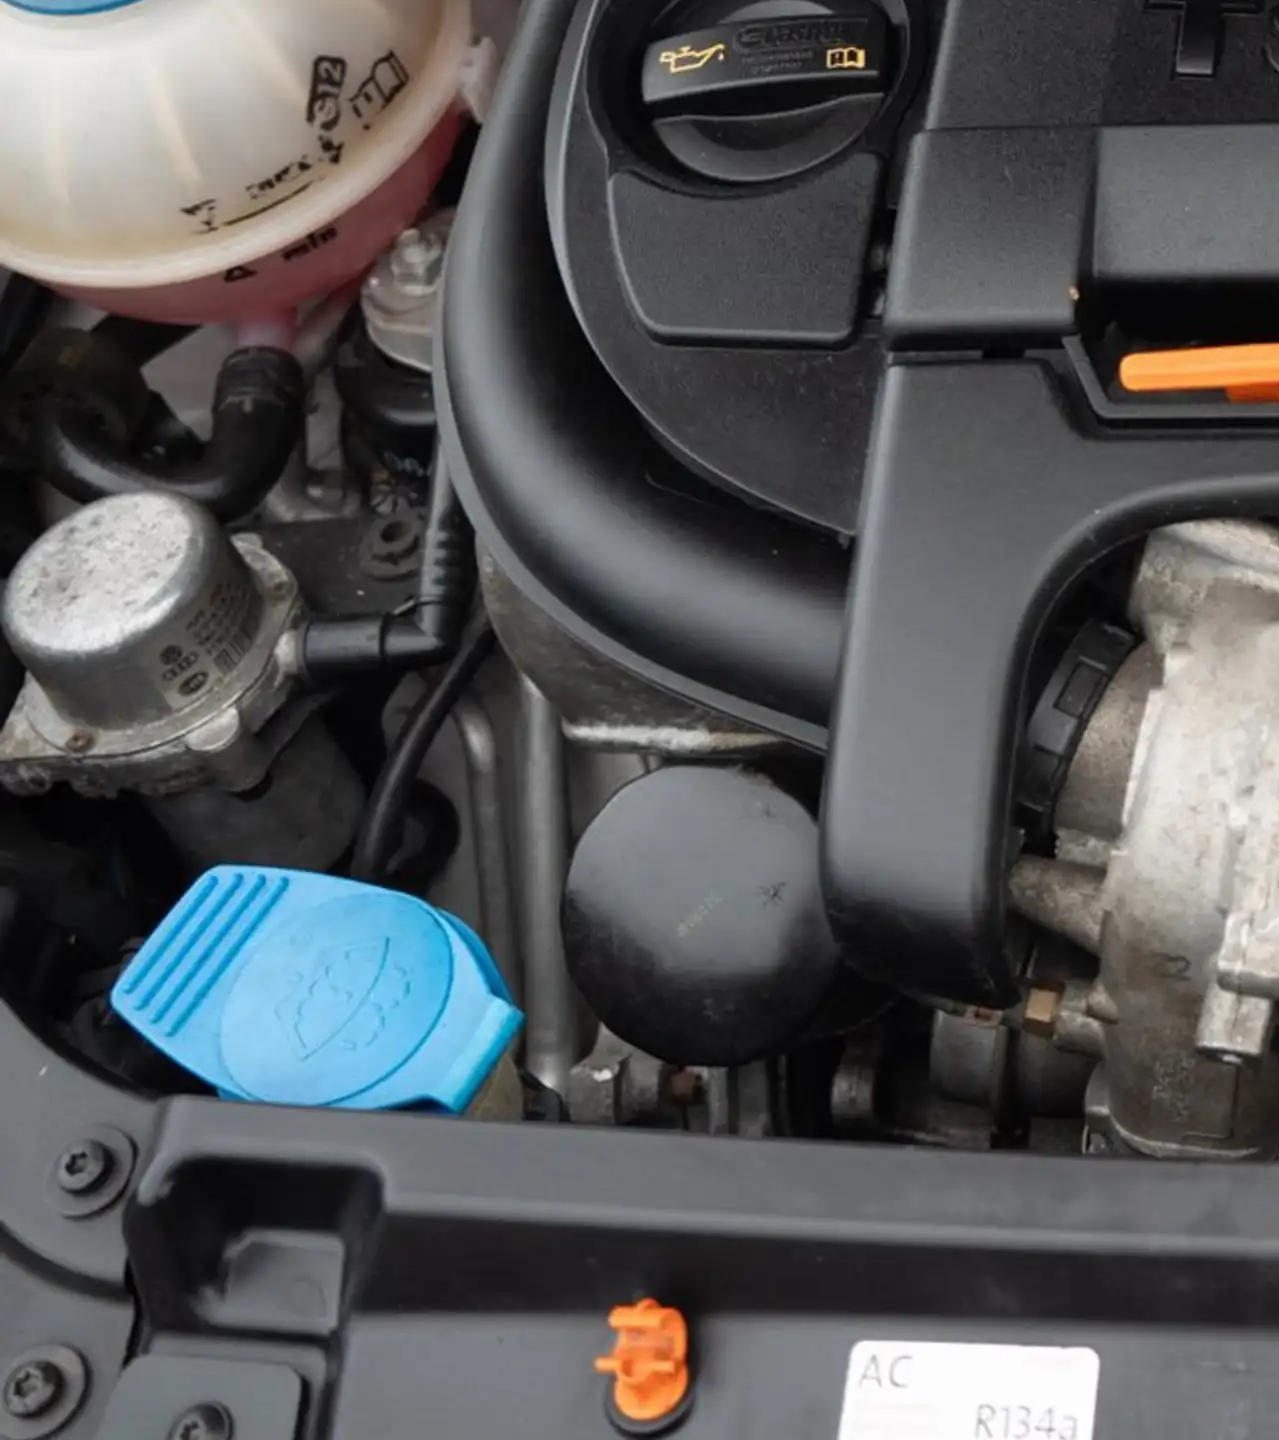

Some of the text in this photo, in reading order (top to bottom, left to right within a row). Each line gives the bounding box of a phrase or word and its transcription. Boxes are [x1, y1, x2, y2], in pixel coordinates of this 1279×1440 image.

[283, 226, 337, 261] min
[858, 1353, 913, 1389] AC
[974, 1403, 1078, 1440] R134a
